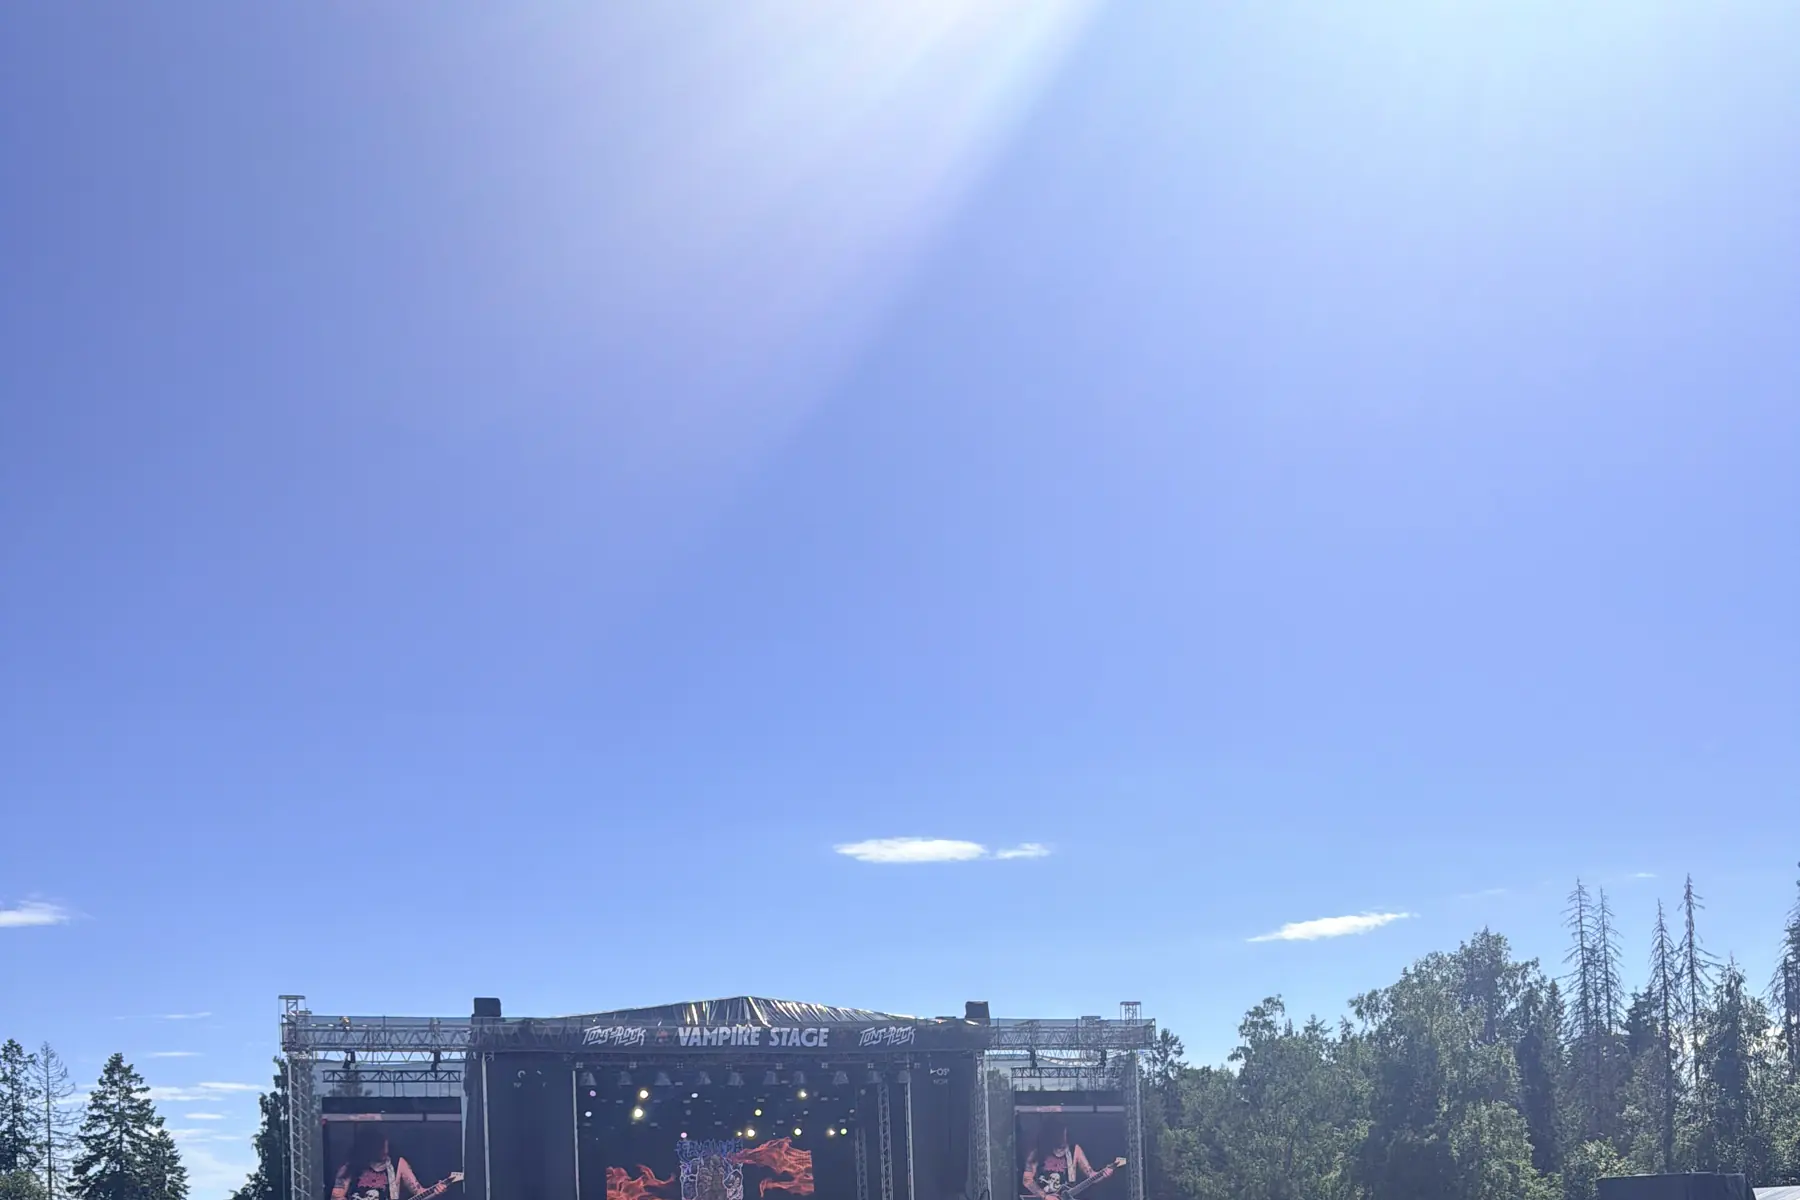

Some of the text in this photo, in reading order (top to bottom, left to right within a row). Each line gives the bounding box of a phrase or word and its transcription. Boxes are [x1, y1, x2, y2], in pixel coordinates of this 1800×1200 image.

[611, 1026, 646, 1046] ROCK
[678, 1026, 829, 1047] VAMPIRE STAGE
[885, 1025, 917, 1046] ROCK
